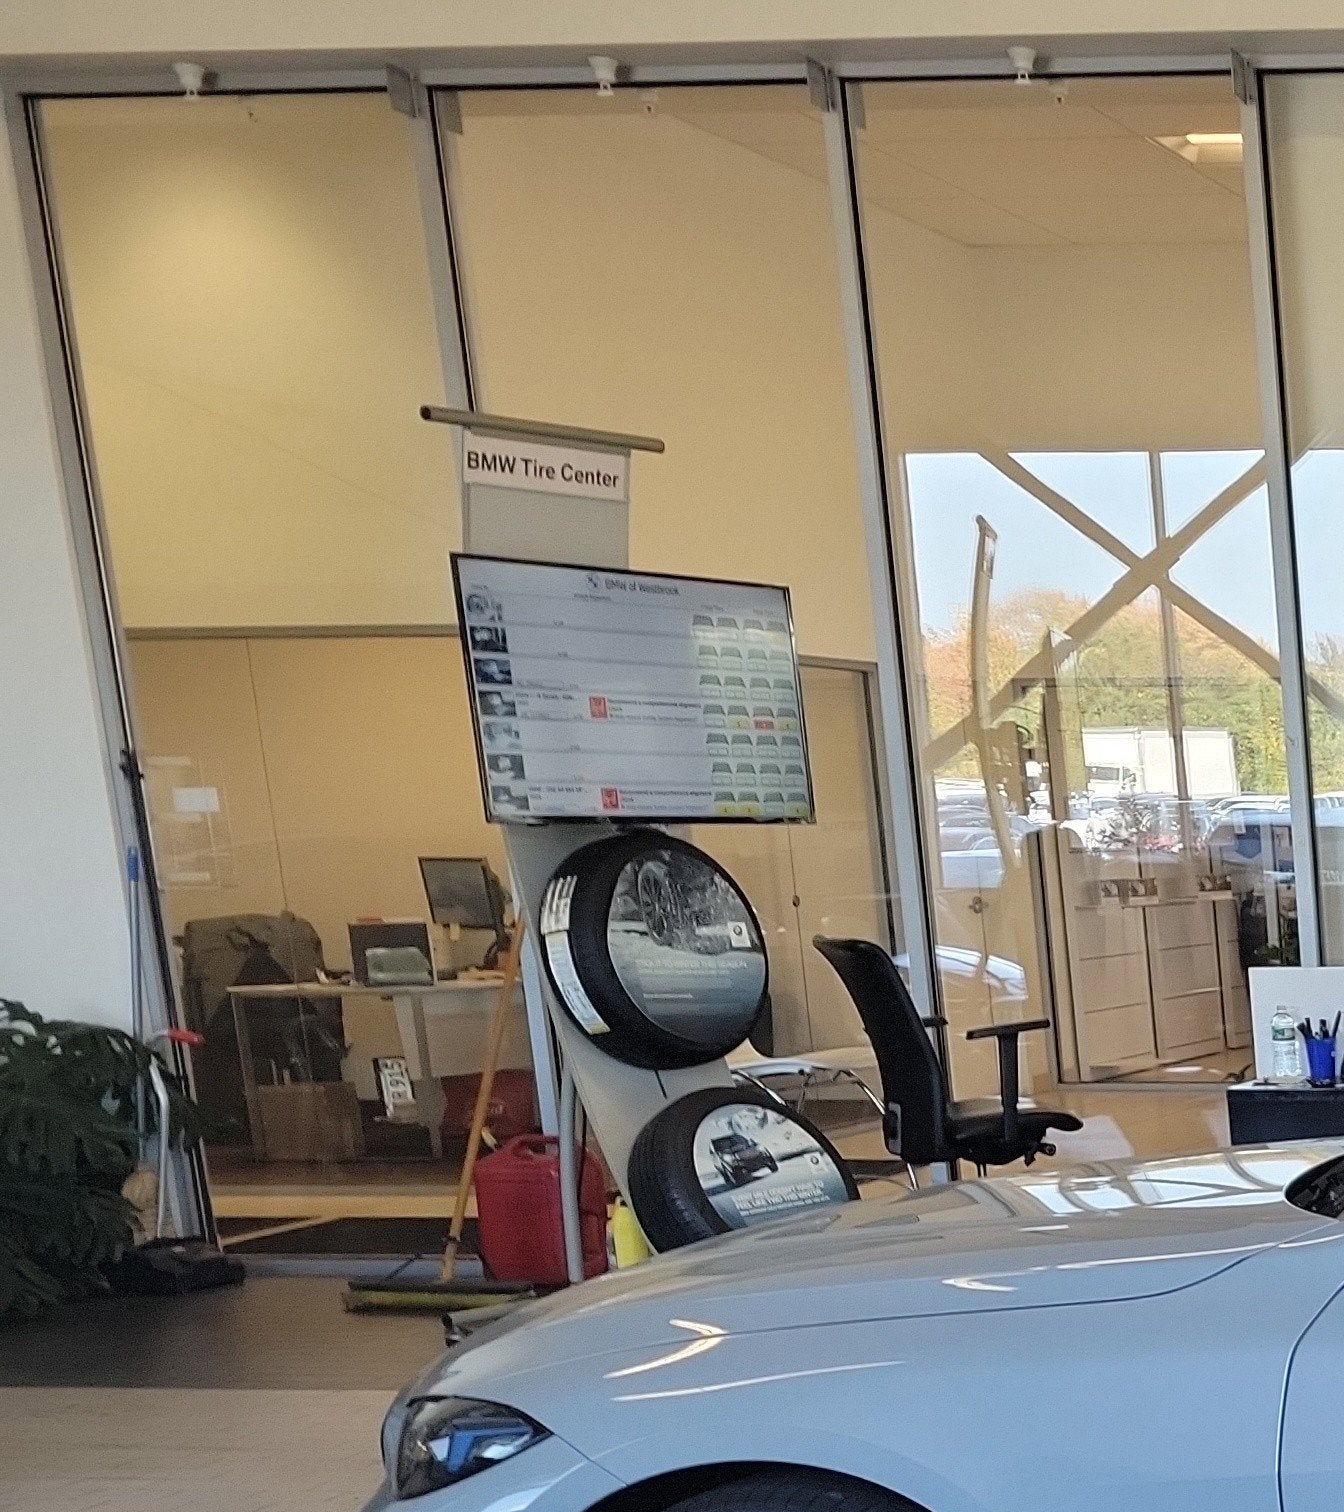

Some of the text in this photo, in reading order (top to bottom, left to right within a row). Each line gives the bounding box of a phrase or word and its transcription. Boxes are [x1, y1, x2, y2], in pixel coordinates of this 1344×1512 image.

[466, 449, 620, 490] BMW Tire Center
